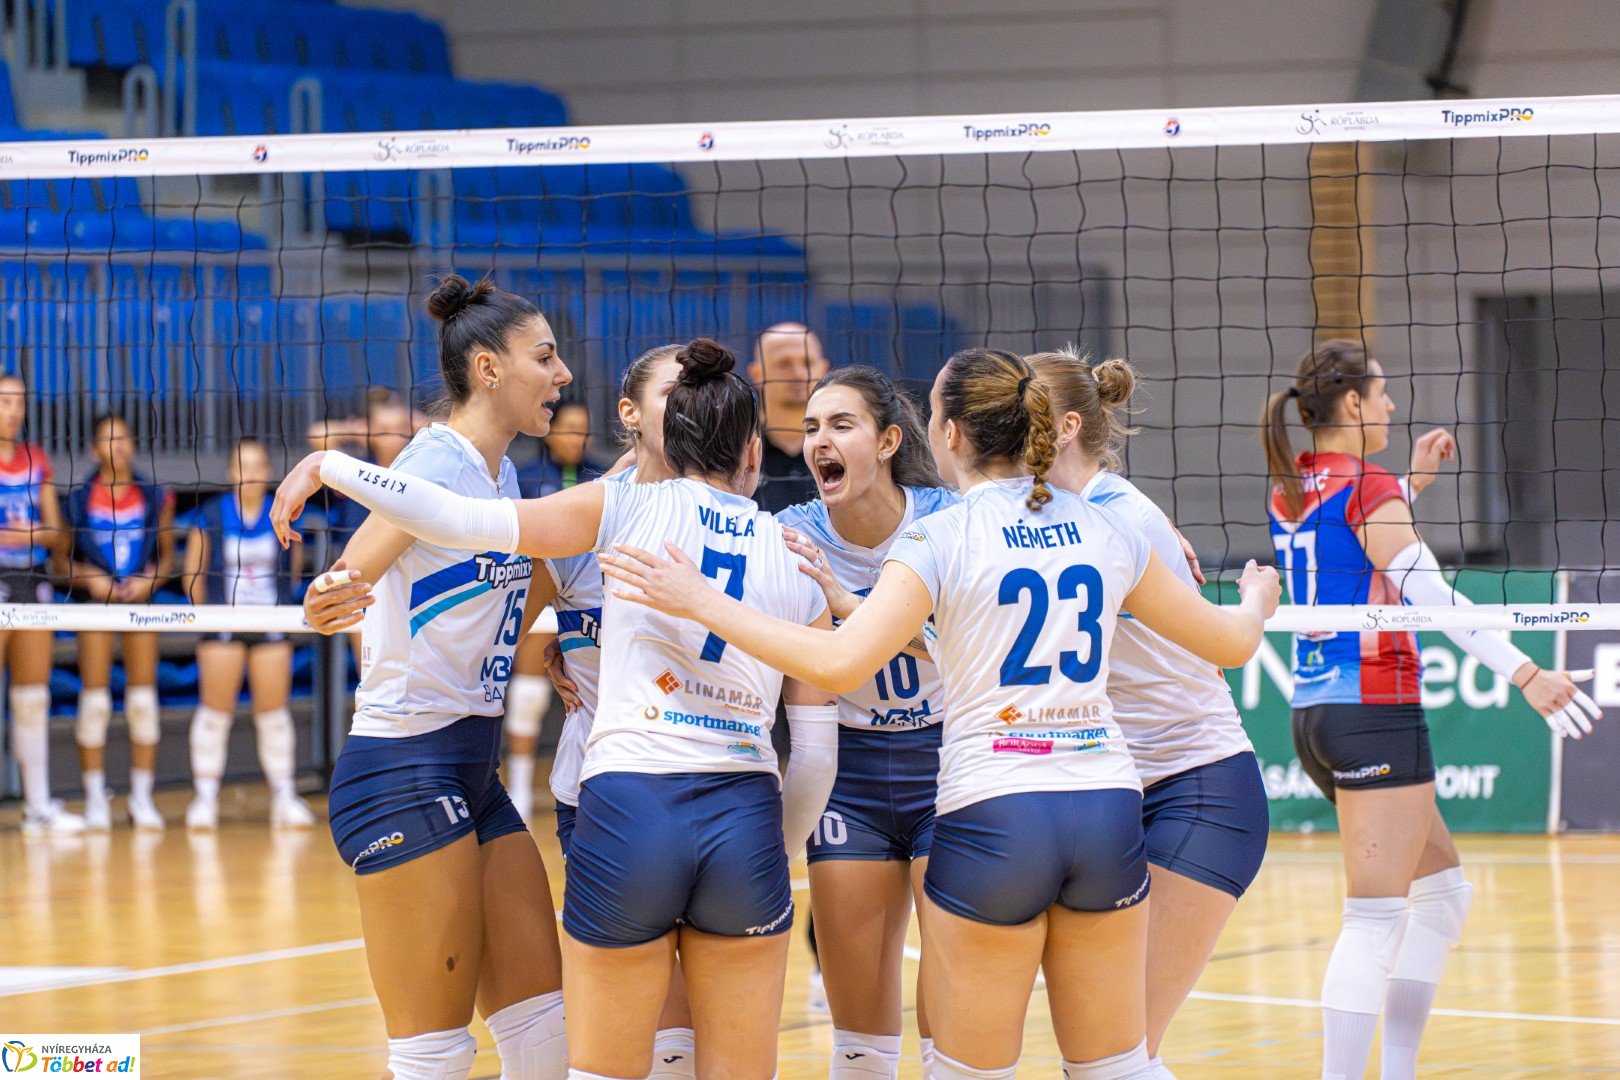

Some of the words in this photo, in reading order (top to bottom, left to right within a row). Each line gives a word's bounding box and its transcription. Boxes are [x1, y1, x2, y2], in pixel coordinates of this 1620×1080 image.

[1442, 107, 1534, 126] TippmixPRO
[507, 136, 590, 153] TippmixPRO
[963, 123, 1051, 141] TippmixPRO
[68, 149, 149, 165] TippmixPRO
[358, 468, 407, 494] KIPSTA
[699, 505, 755, 537] VILELA
[1002, 518, 1082, 549] NÉMETH
[1273, 530, 1317, 605] 77
[494, 588, 526, 646] 15
[699, 544, 746, 663] 7
[129, 612, 196, 626] TippmixPRO
[998, 564, 1104, 687] 23
[1513, 611, 1590, 626] TippmixPRO
[875, 652, 920, 701] 10
[483, 685, 507, 703] BA
[684, 680, 763, 709] LINAMAR
[1028, 705, 1101, 722] LINAMAR
[813, 810, 847, 846] 10
